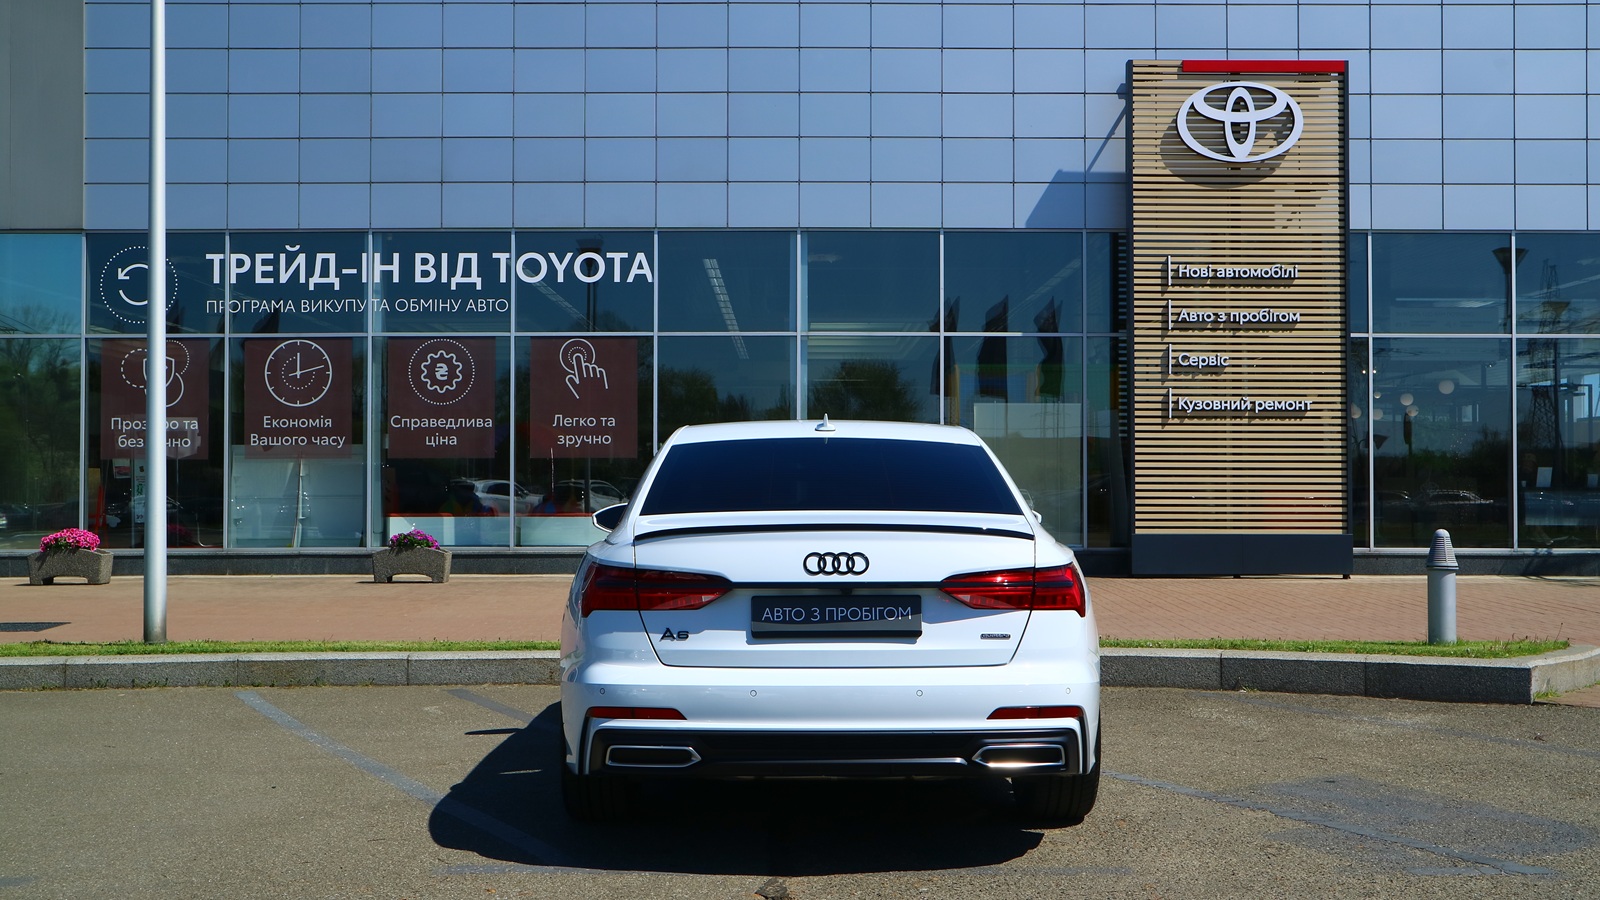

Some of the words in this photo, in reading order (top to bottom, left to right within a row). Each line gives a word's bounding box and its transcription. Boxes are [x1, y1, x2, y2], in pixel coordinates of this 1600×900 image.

[206, 244, 399, 290] ТРЕЙД-ІН
[414, 252, 482, 290] ВІД
[492, 252, 654, 284] TOYOTA
[1178, 264, 1213, 279] Нові
[1216, 264, 1299, 279] автомобілі
[206, 299, 296, 314] ПРОГРАМА
[301, 299, 367, 313] ВИКУПУ
[371, 298, 390, 312] ТА
[395, 298, 462, 313] ОБМІНУ
[466, 298, 509, 312] АВТО
[1178, 308, 1214, 322] Авто
[1217, 311, 1226, 322] з
[1230, 308, 1301, 325] пробігом
[1178, 353, 1230, 369] Сервіс
[1178, 396, 1251, 413] Кузовний
[1255, 399, 1313, 413] ремонт
[111, 417, 179, 433] Прозо
[183, 420, 199, 430] та
[263, 415, 333, 428] Економія
[390, 415, 493, 430] Справедлива
[552, 414, 597, 428] Легко
[600, 415, 616, 427] та
[118, 434, 191, 448] безчно
[250, 434, 307, 447] Вашого
[311, 435, 346, 448] часу
[425, 433, 458, 447] ціна
[557, 434, 612, 447] зручно
[762, 607, 806, 621] АВТО
[810, 607, 820, 621] З
[825, 606, 912, 621] ПРОБІГОМ
[660, 627, 690, 641] A6
